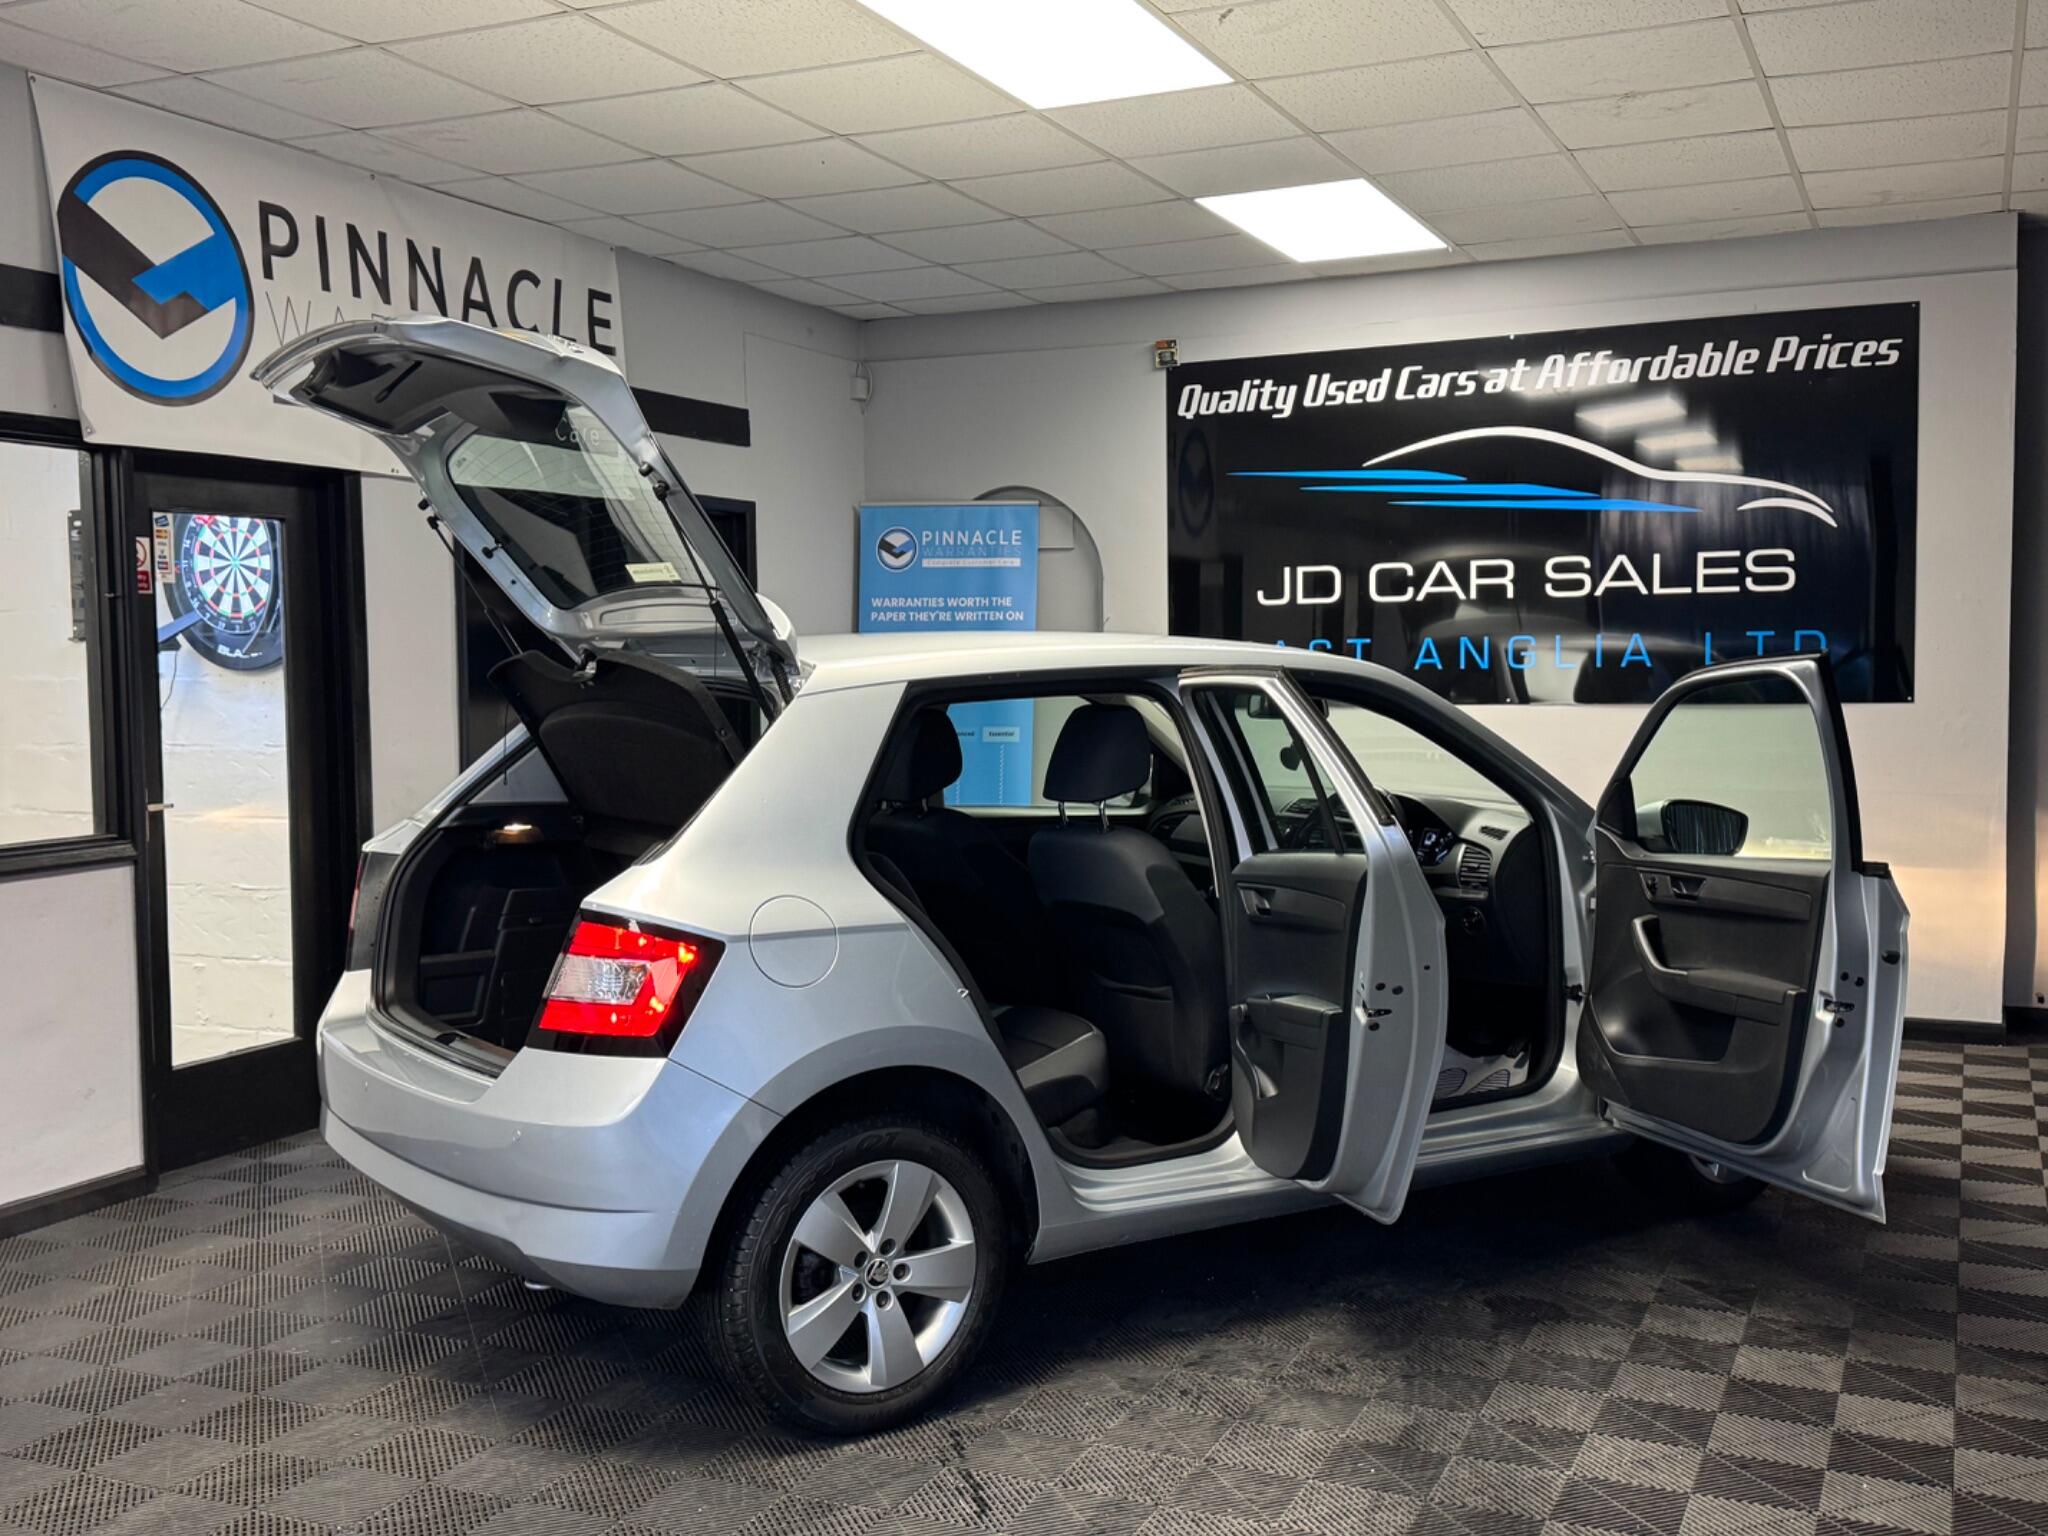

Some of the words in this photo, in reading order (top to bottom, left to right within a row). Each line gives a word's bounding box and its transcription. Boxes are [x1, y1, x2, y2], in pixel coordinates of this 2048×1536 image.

[258, 199, 617, 357] PINNACLE
[1177, 378, 1298, 420] Quality
[1302, 367, 1393, 408] Used
[1394, 365, 1480, 401] Cars
[1483, 357, 1530, 394] at
[1535, 339, 1760, 390] Affordable
[1766, 333, 1903, 373] Prices
[922, 530, 1022, 545] PINNACLE
[1257, 564, 1342, 606] JD
[1368, 558, 1515, 603] CAR
[1544, 548, 1796, 598] SALES
[871, 597, 944, 608] WARRANTIES
[948, 597, 989, 607] WORTH
[991, 597, 1012, 606] THE
[871, 612, 906, 622] PAPER
[909, 611, 951, 622] THEY'RE
[955, 611, 1003, 621] WRITTEN
[1006, 610, 1024, 620] ON
[1414, 633, 1652, 670] ANGLIA
[1704, 630, 1828, 666] LTD
